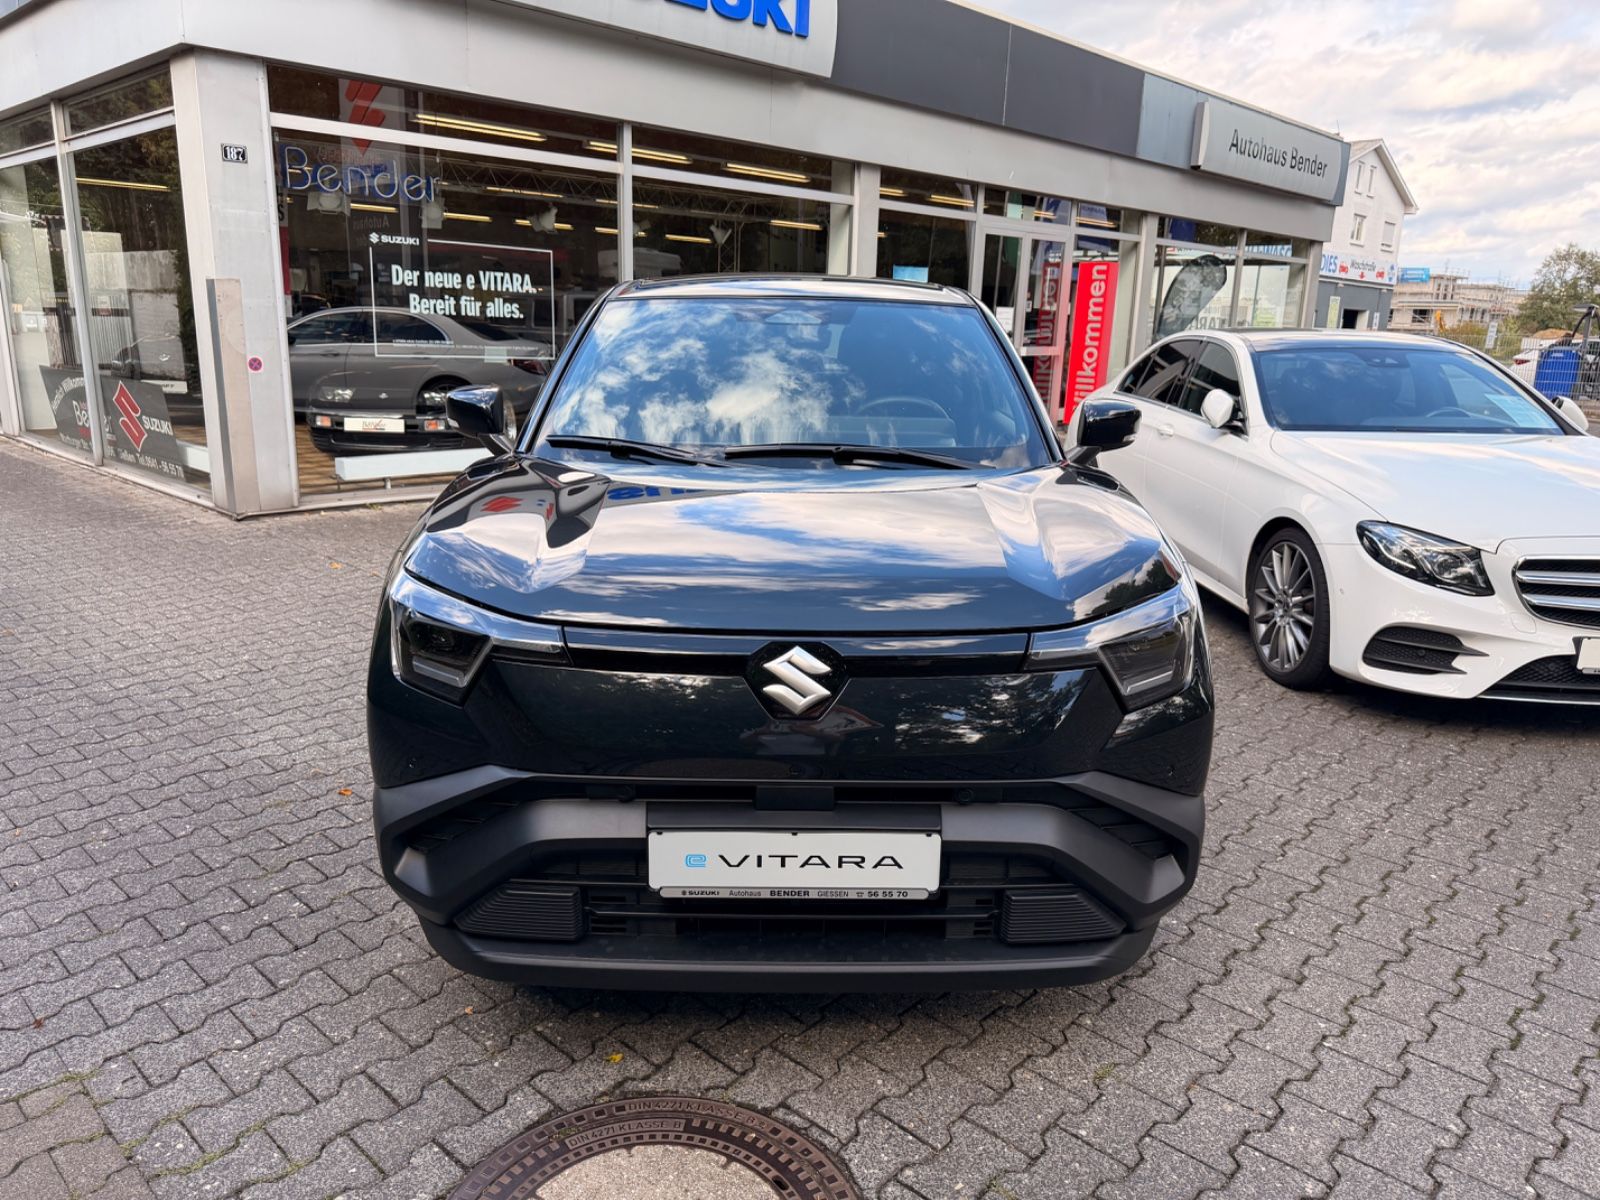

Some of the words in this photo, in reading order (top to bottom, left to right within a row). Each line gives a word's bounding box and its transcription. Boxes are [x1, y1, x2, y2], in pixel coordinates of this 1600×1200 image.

[225, 146, 244, 161] 187
[1228, 128, 1287, 168] Autohaus
[1290, 147, 1328, 178] Bender
[283, 145, 440, 203] Bender
[381, 234, 420, 246] SUZUKI
[390, 264, 420, 287] Der
[424, 270, 462, 290] neue
[466, 273, 475, 290] e
[409, 293, 456, 316] Bereit
[460, 298, 482, 317] für
[486, 297, 524, 319] alles.
[1072, 263, 1108, 410] illkommen
[142, 414, 174, 437] SUZUKI
[718, 855, 904, 870] VITARA
[728, 889, 762, 897] Autohaus
[817, 890, 849, 898] GIESSEN
[628, 1102, 650, 1112] DIN
[653, 1101, 683, 1111] 4271
[686, 1102, 743, 1120] KLASSE
[568, 1133, 590, 1147] DIN
[591, 1125, 615, 1138] 4271
[618, 1119, 667, 1131] KLASSE
